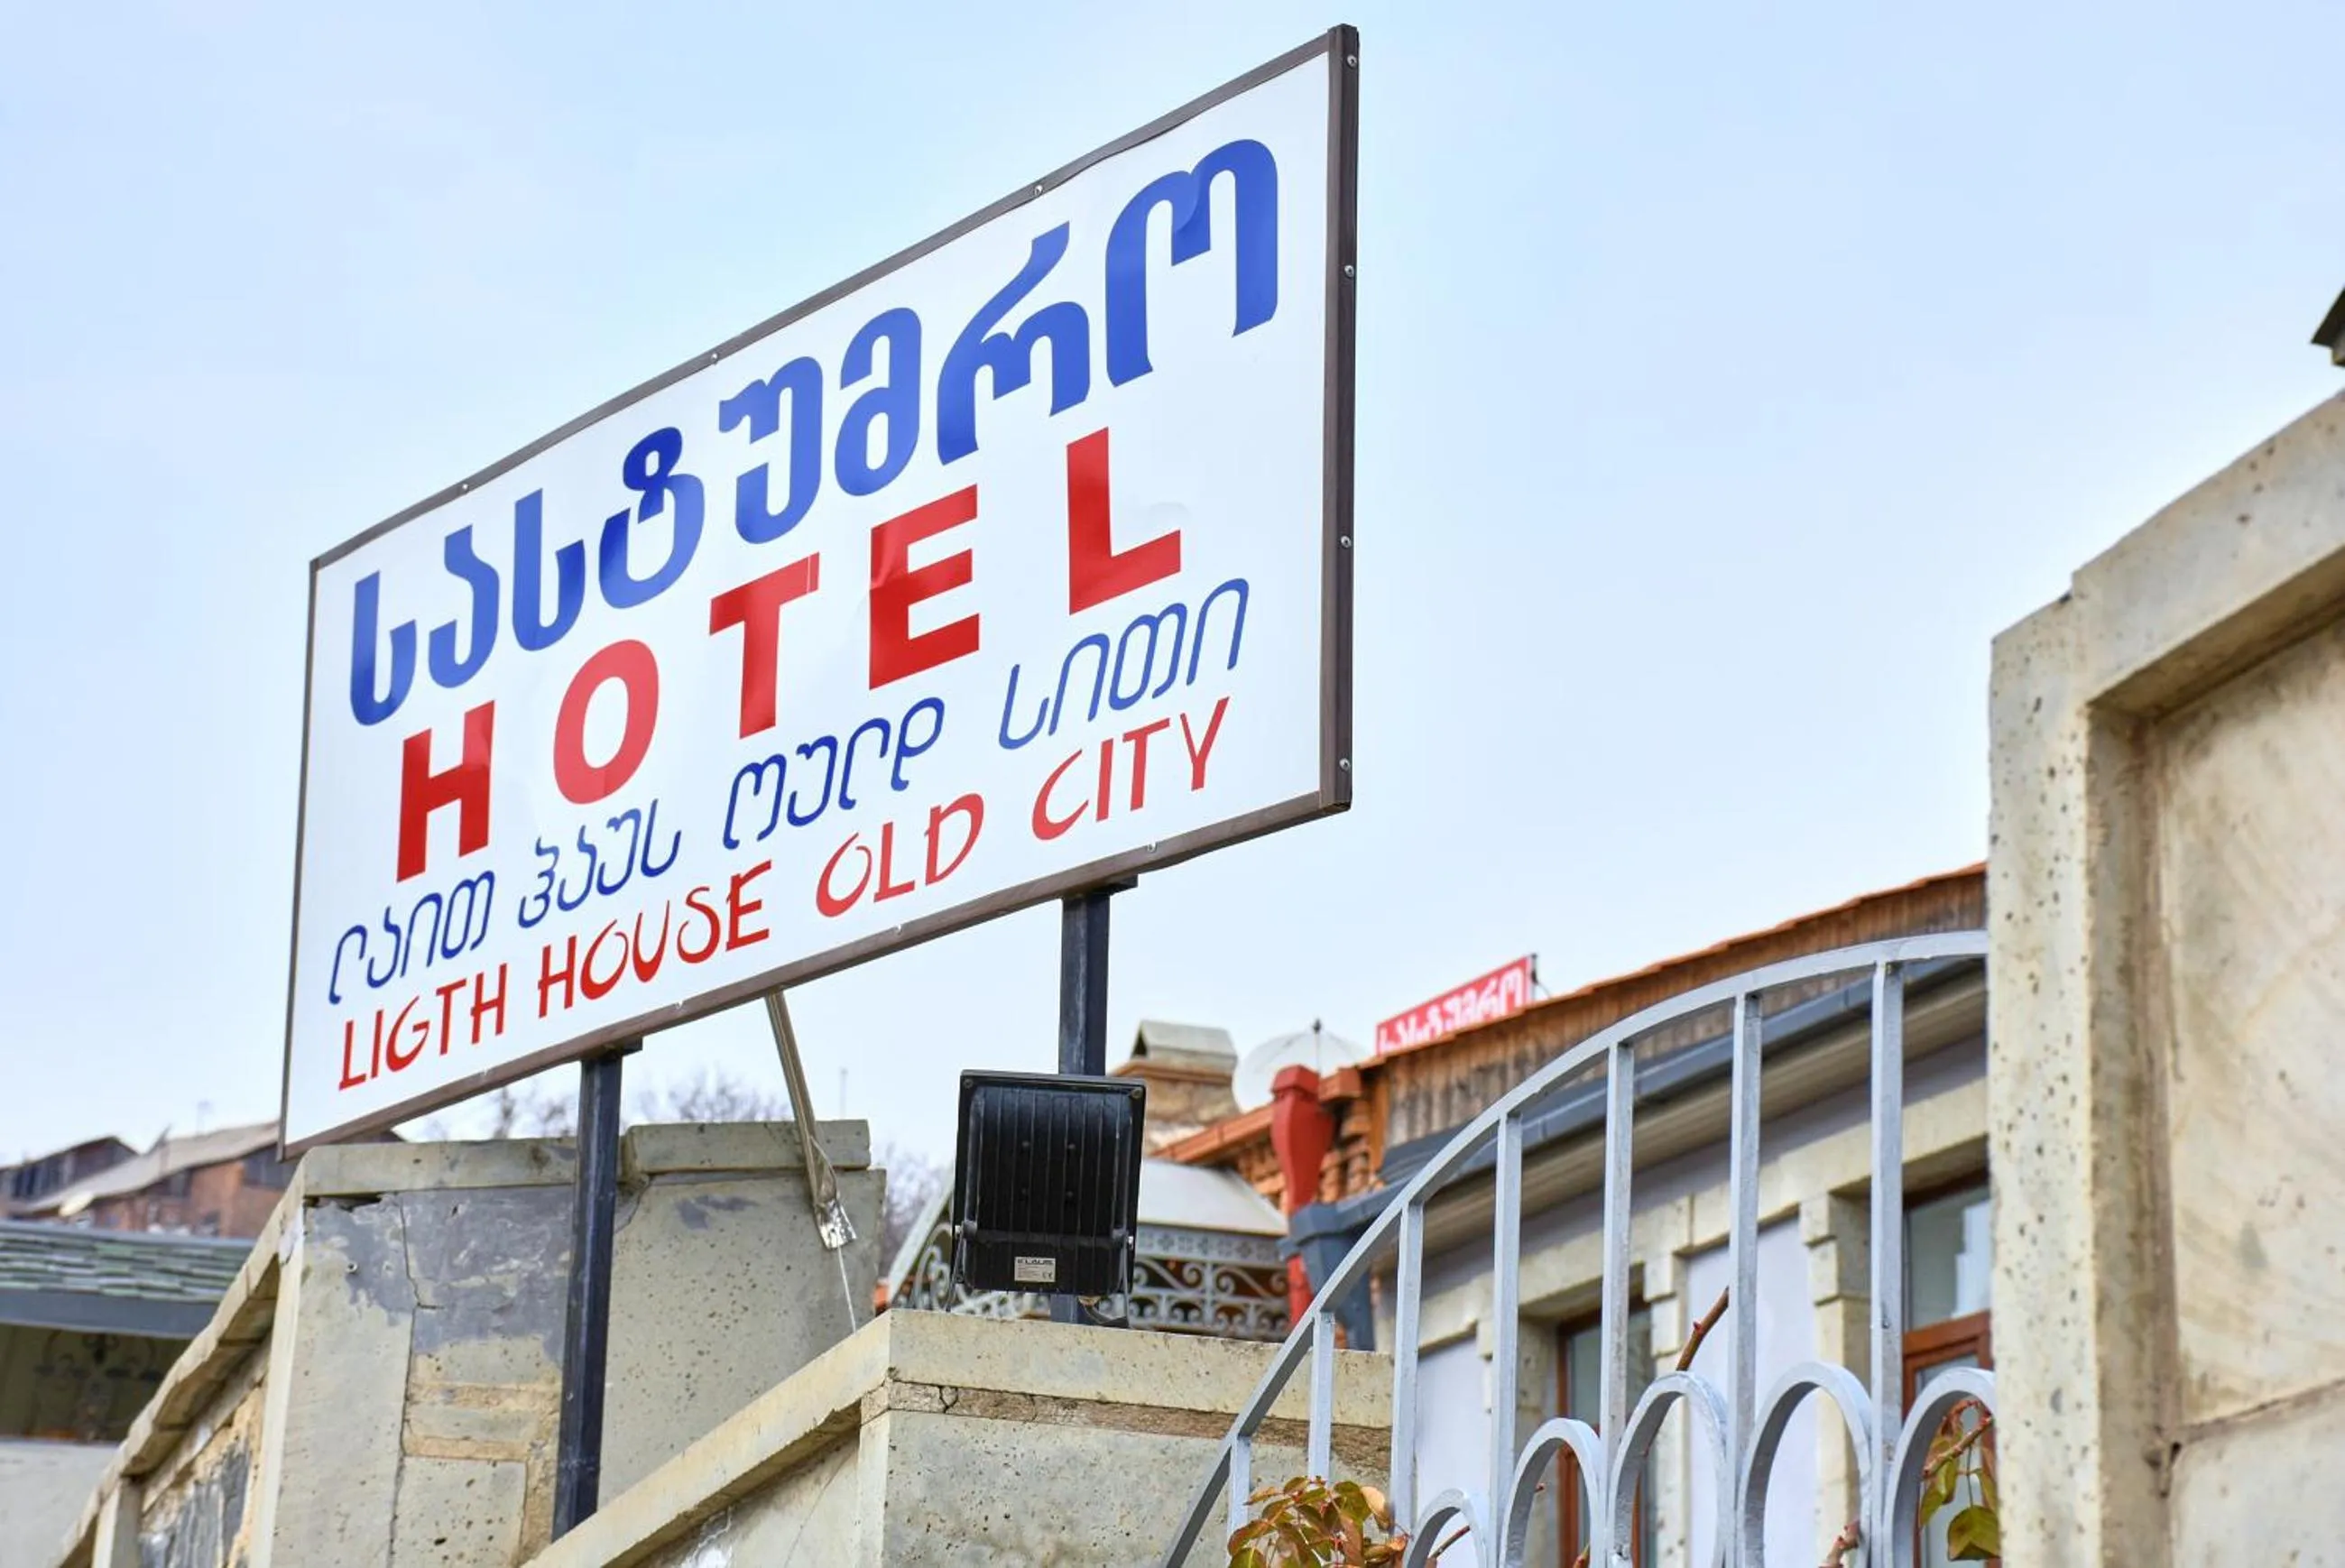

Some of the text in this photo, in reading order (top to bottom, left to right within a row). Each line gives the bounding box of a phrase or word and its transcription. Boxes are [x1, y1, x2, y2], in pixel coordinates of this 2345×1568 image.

[350, 139, 1279, 725] სასტუმრო
[328, 577, 1250, 1006] ლაით ჰაუს ოულდ სითი
[397, 429, 1182, 881] HOTEL
[339, 696, 1231, 1092] LIGTH HOUSE OLD CITY
